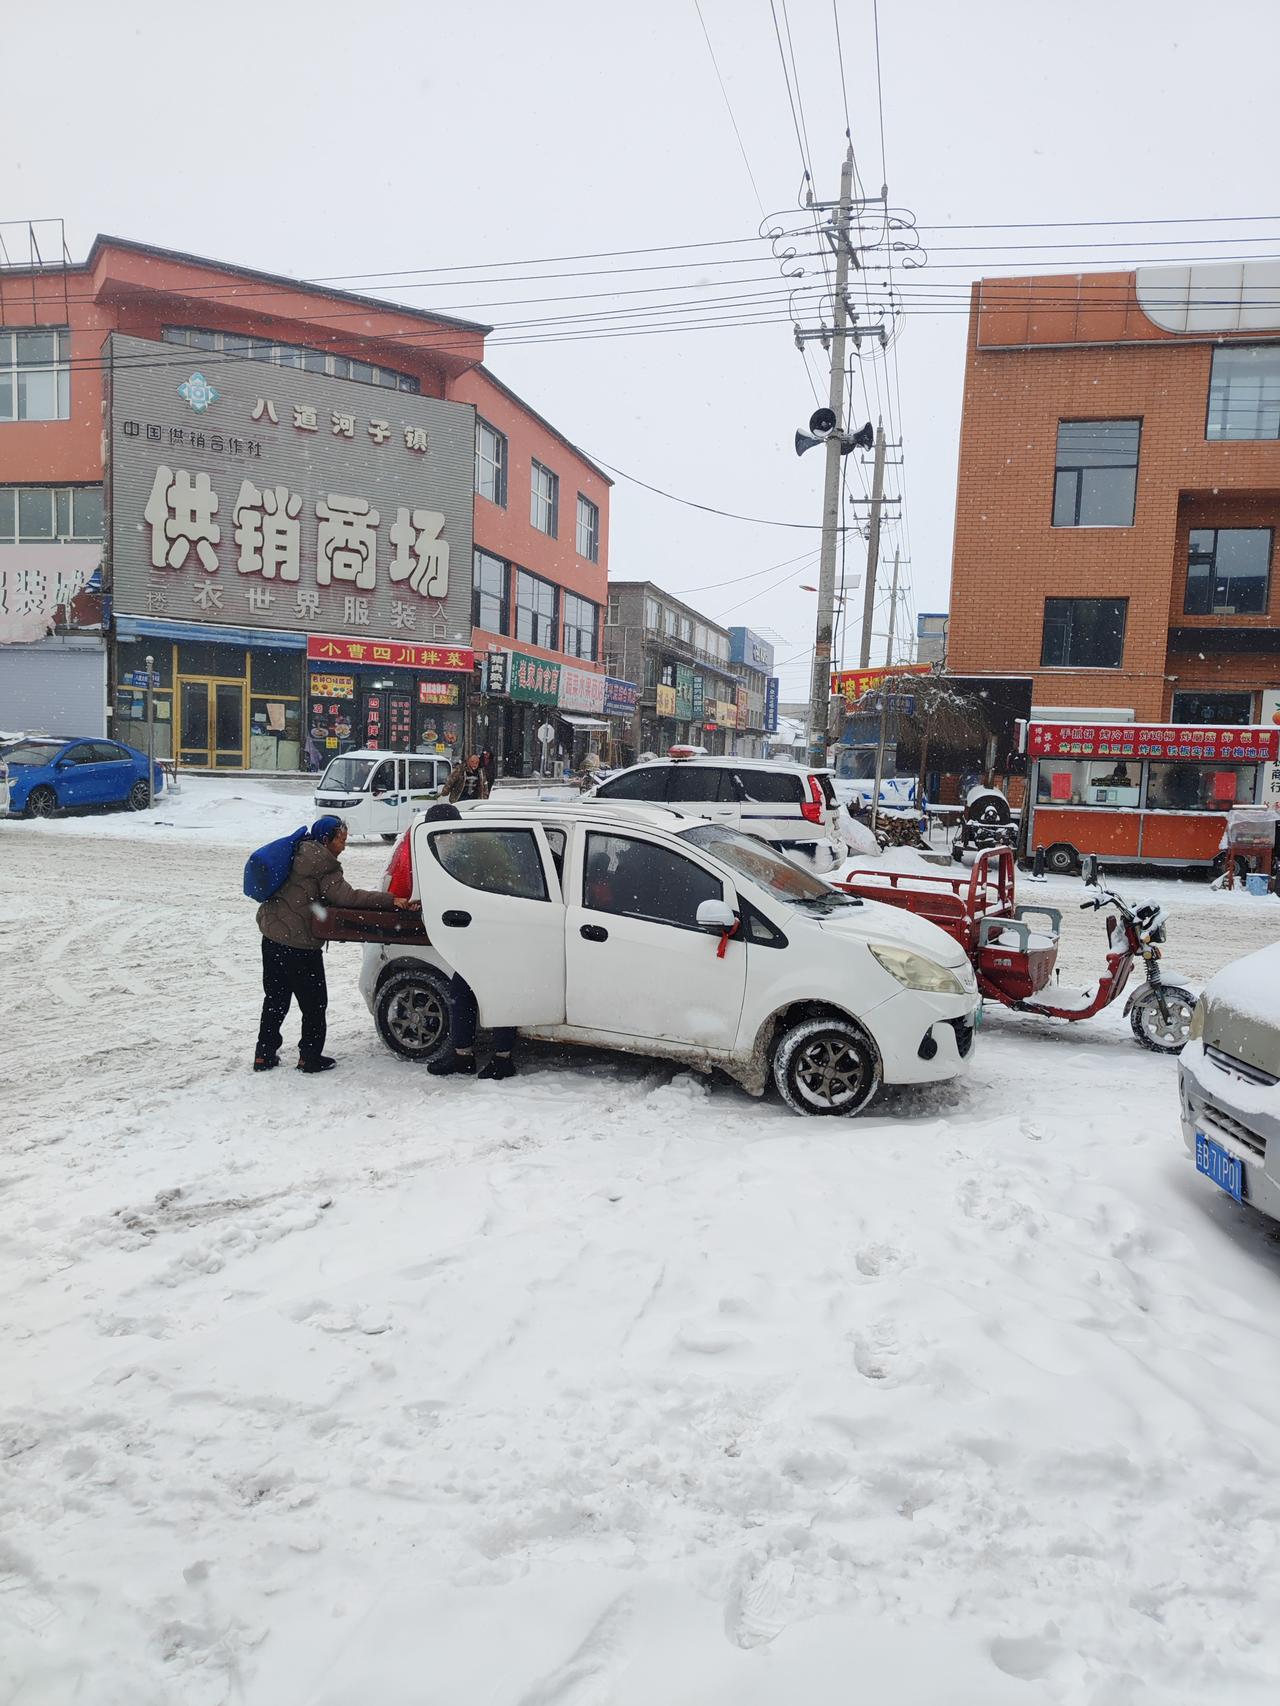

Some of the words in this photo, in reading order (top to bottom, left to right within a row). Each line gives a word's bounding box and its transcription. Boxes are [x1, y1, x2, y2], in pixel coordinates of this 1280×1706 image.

[123, 420, 264, 458] 中国供销合作社
[251, 397, 430, 453] 八道河子镇
[143, 464, 450, 599] 供销商场
[193, 579, 418, 632] 衣世界服装
[431, 600, 449, 640] 入口
[319, 642, 465, 667] 小曹四川拌菜
[1059, 728, 1095, 740] 手抓饼
[1099, 729, 1135, 741] 烤冷面
[1139, 730, 1175, 742] 炸鸡柳
[1098, 743, 1134, 754] 臭豆腐
[1220, 746, 1269, 759] 甘梅地瓜
